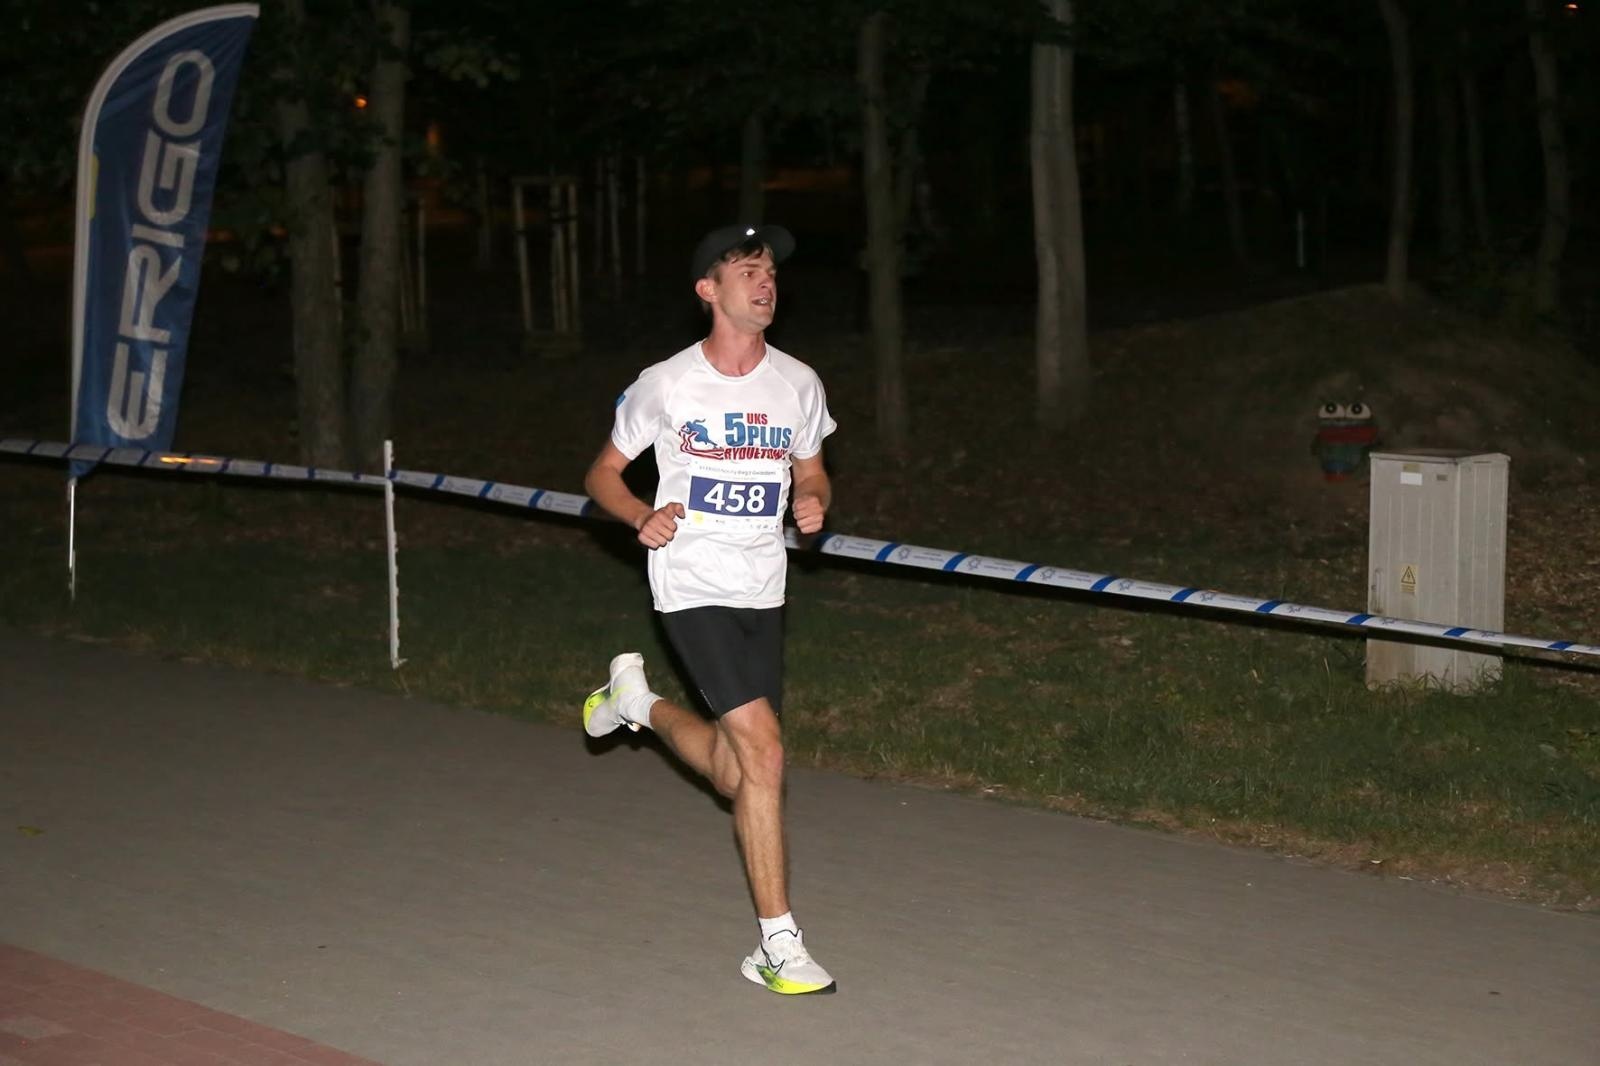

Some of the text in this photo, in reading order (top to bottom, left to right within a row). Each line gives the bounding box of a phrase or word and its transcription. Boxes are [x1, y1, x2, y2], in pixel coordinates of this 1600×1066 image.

[724, 412, 792, 449] 5 PLUS
[746, 412, 768, 425] UKS
[703, 482, 766, 513] 458
